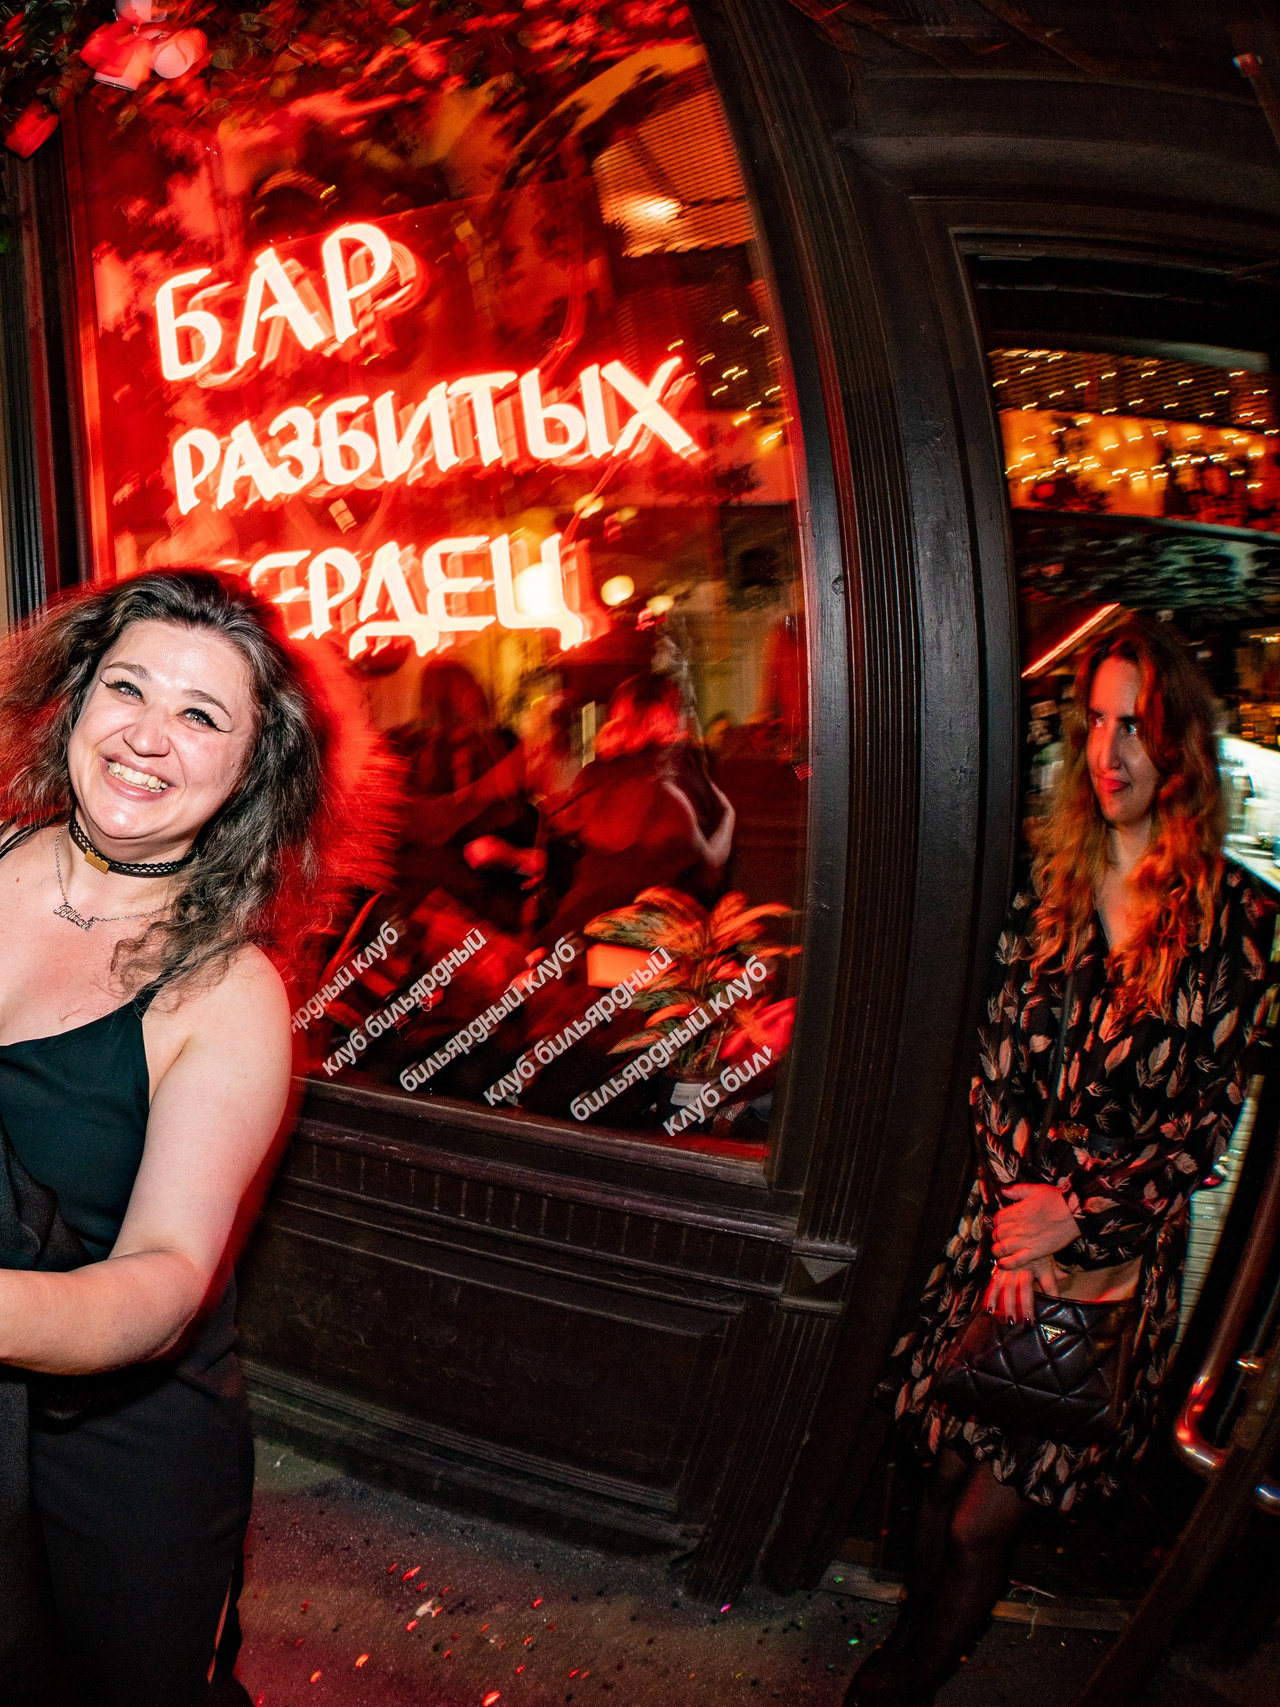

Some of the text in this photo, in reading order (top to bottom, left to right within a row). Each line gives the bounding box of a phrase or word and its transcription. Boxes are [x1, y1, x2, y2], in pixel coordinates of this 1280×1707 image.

[153, 222, 393, 381] БАР
[172, 356, 696, 515] РАЗБИТЫХ
[250, 532, 584, 661] ЕРДЕЦ
[53, 903, 96, 933] Bitch
[351, 921, 399, 974] клуб
[322, 928, 487, 1077] клуб бильярдный
[399, 937, 575, 1092] бильярдный клуб
[483, 946, 672, 1106] клуб бильярдный
[570, 955, 768, 1121] бильярдный клуб
[663, 1082, 721, 1137] клуб
